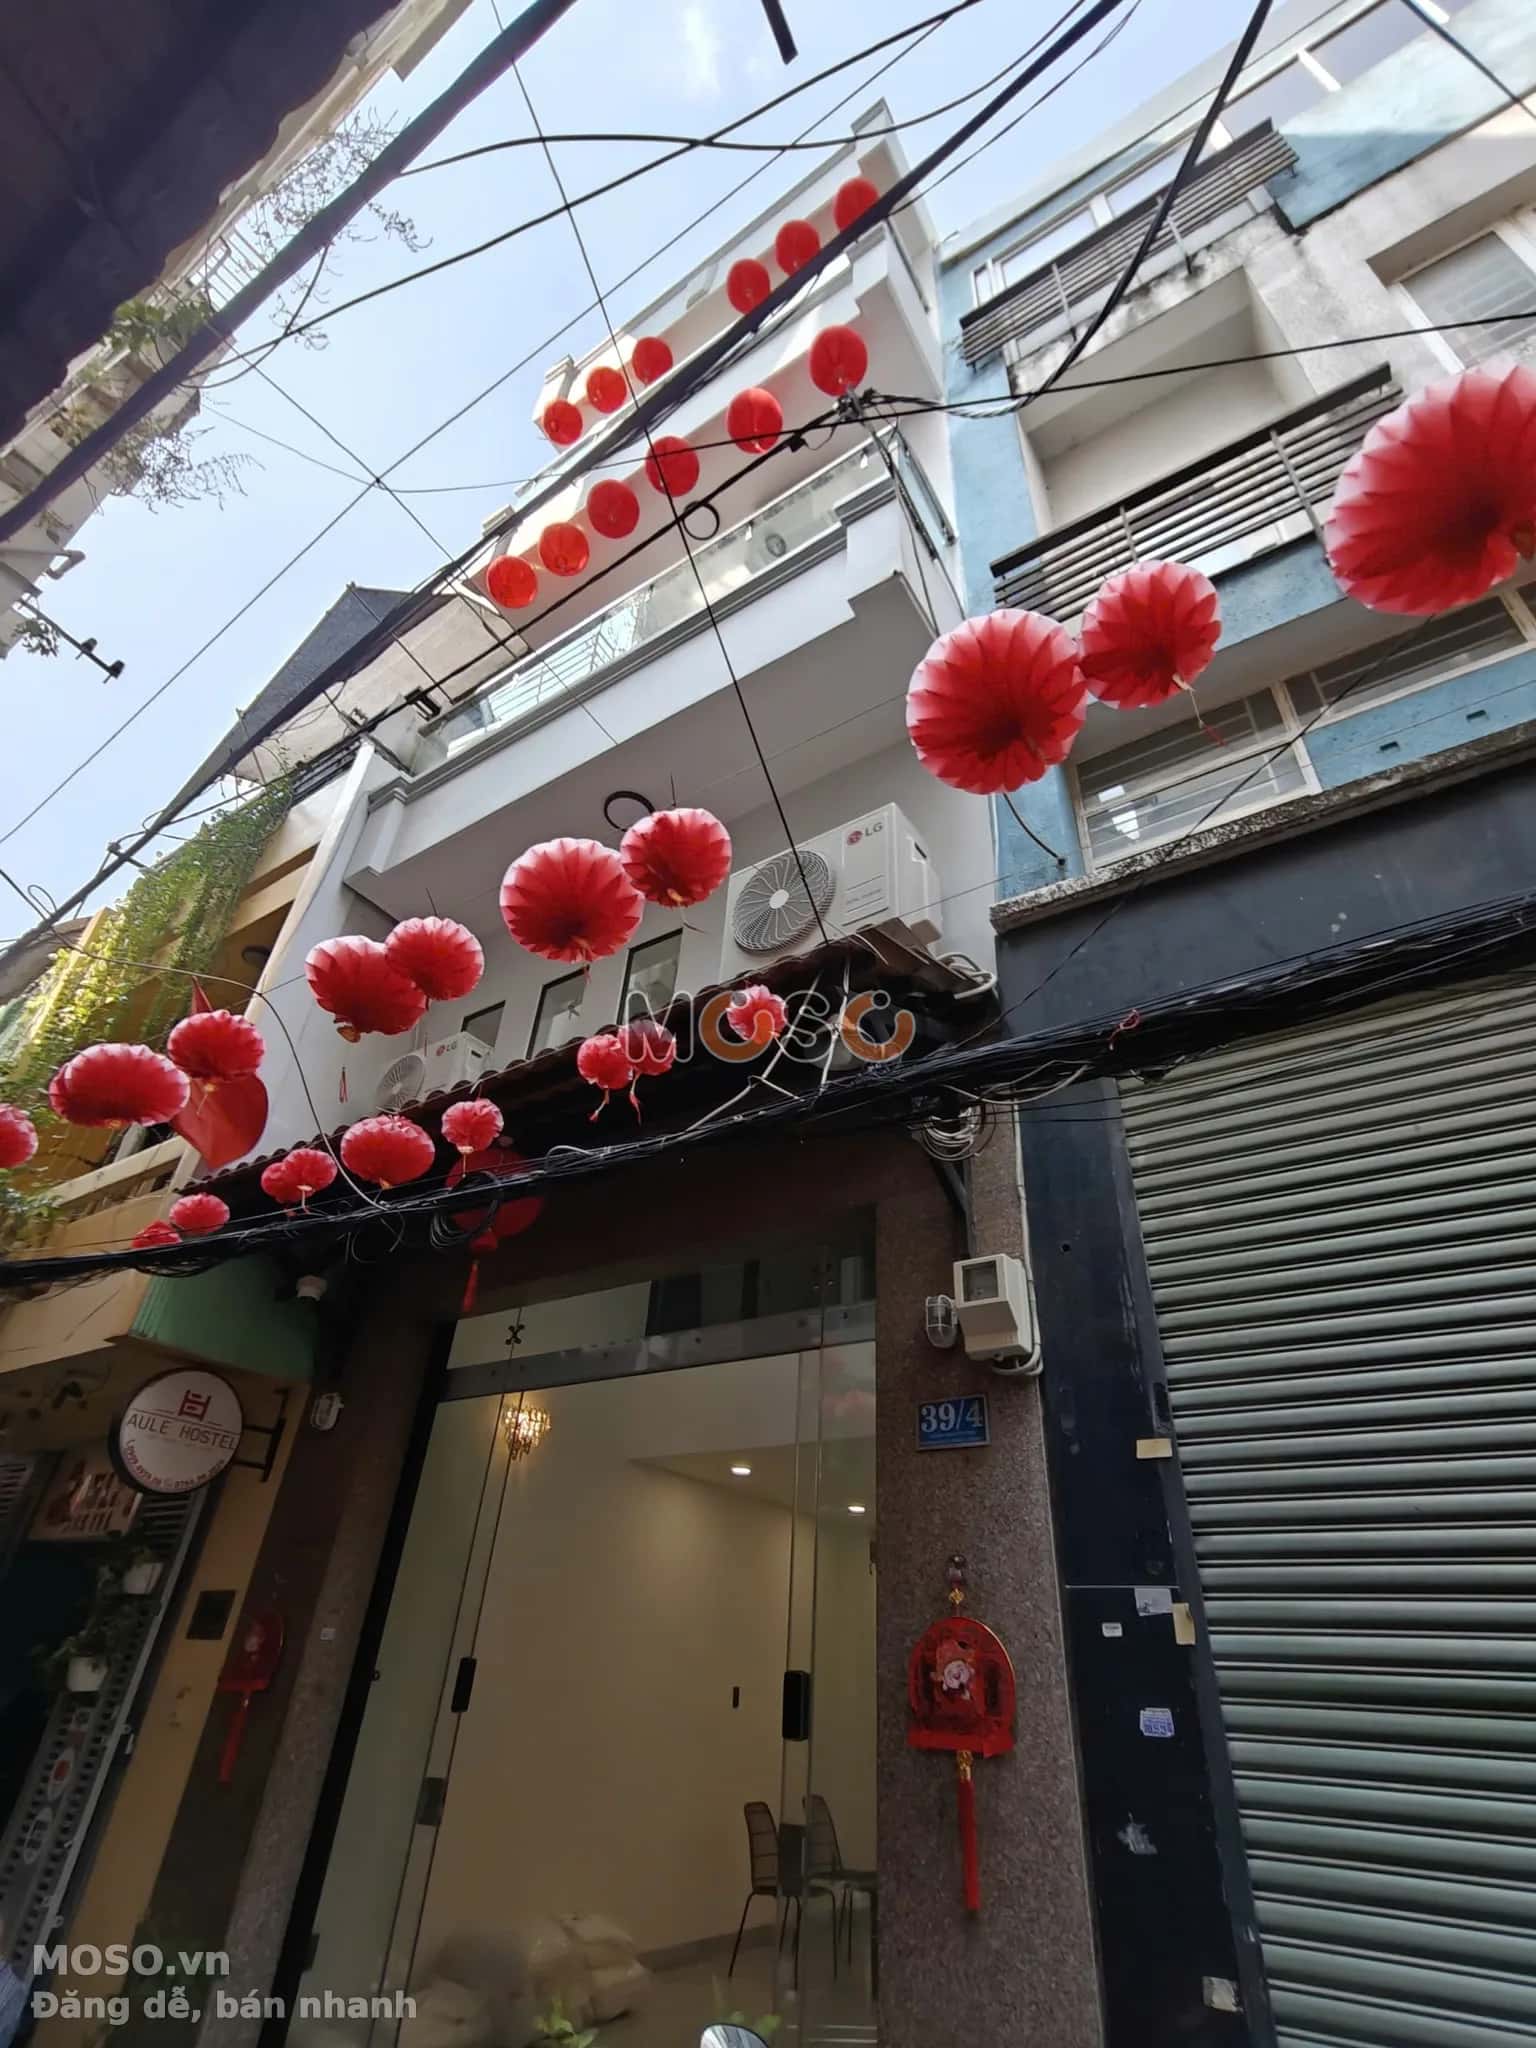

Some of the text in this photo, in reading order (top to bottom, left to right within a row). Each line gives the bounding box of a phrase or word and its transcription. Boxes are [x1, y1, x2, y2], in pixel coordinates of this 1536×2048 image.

[865, 822, 883, 837] LG
[127, 1413, 240, 1450] AULE HOSTEL
[921, 1401, 983, 1432] 39/4
